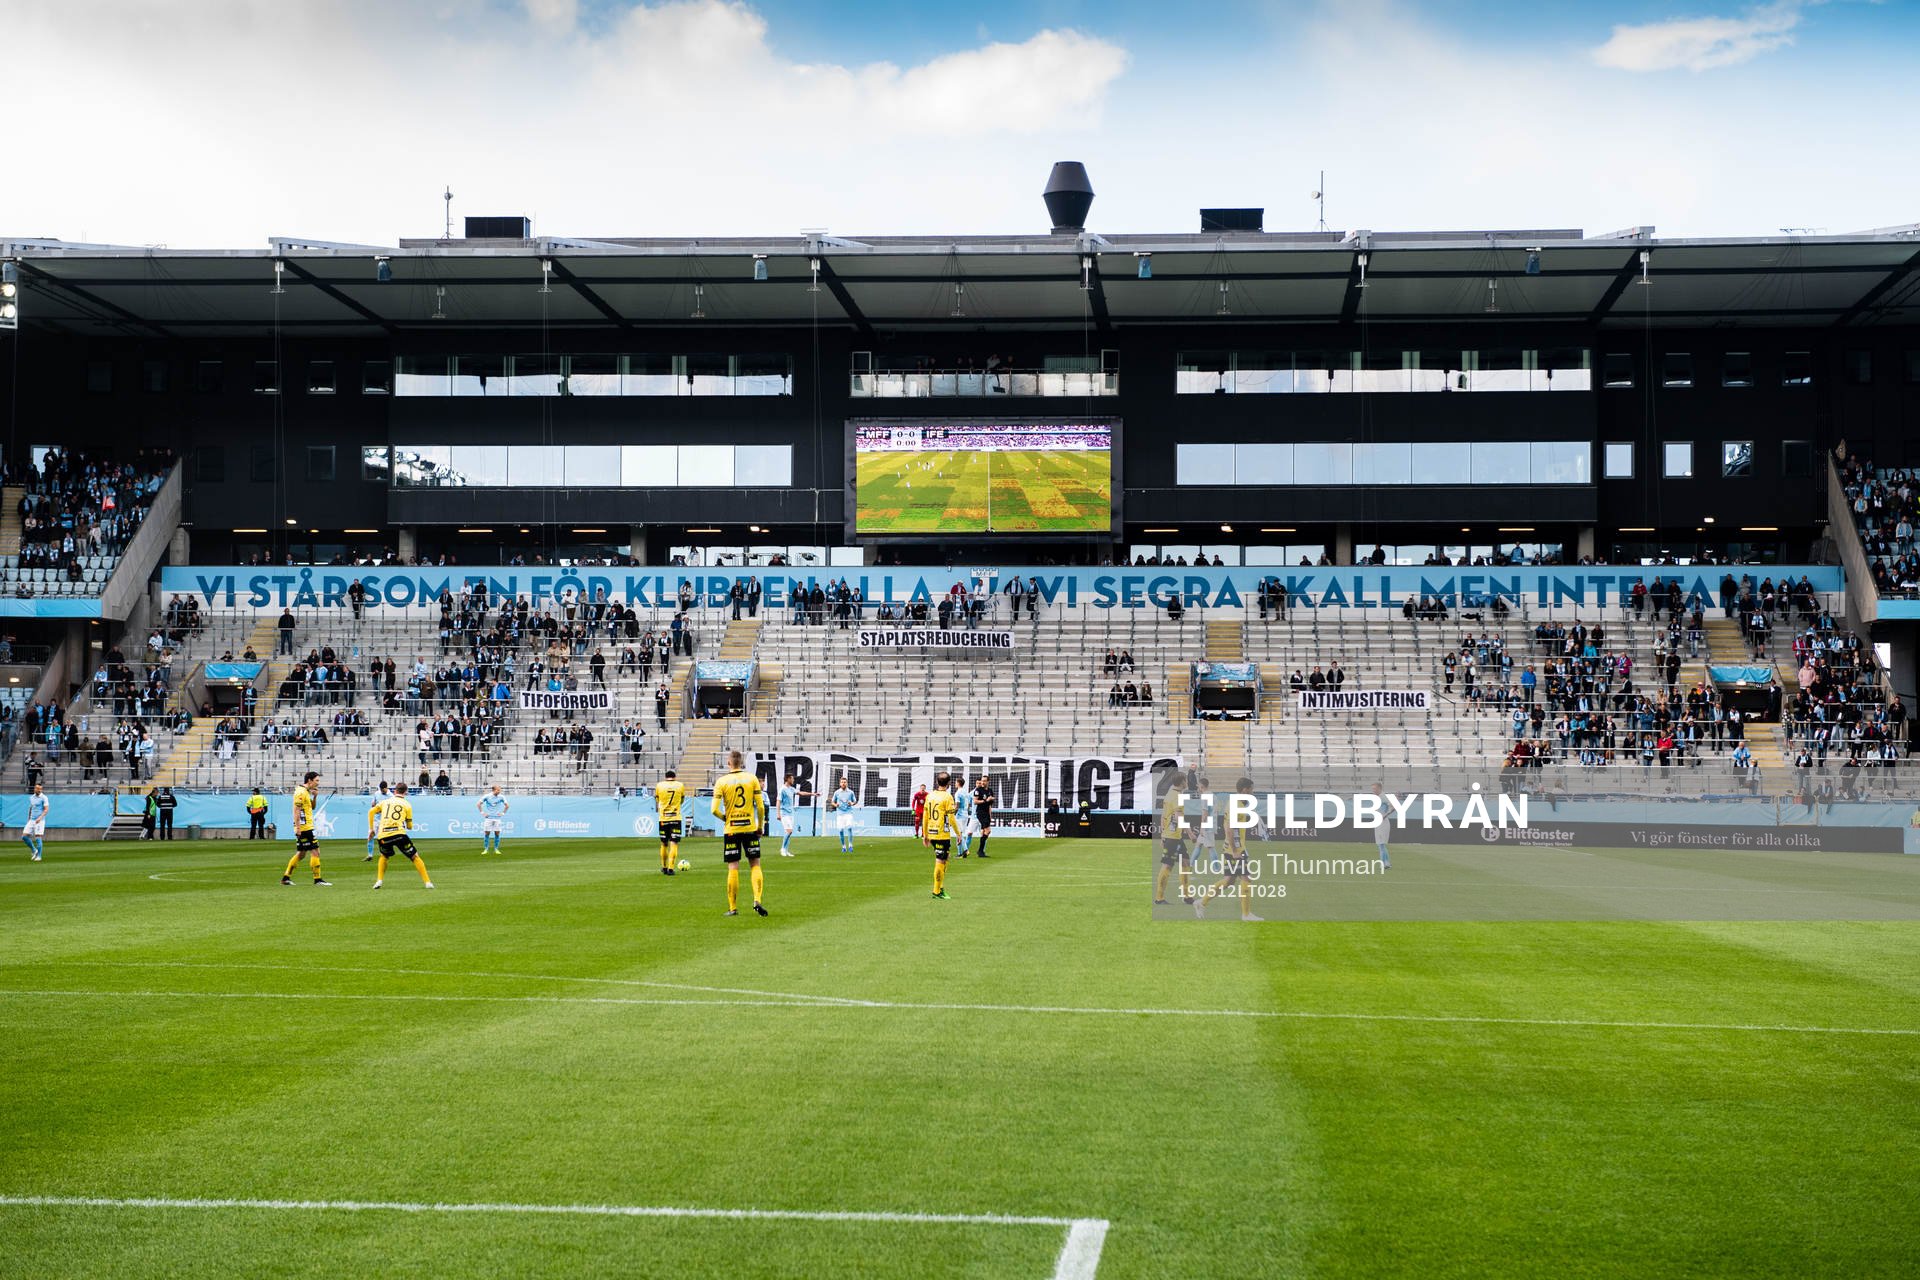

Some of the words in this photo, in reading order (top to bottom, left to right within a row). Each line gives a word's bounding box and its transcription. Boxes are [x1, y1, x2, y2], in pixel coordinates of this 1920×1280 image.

[866, 430, 889, 438] MFF
[926, 430, 944, 438] IFE
[196, 576, 235, 608] VI
[247, 567, 350, 608] STÅR
[366, 575, 450, 608] SOM
[531, 568, 613, 608] FÖR
[829, 576, 936, 608] LLA
[1034, 576, 1077, 608] VI
[1092, 575, 1244, 608] SEGRA
[1420, 576, 1520, 608] MEN
[1538, 576, 1644, 608] INTE
[522, 691, 608, 709] TIFOFÖRBUD
[1302, 691, 1425, 708] INTIMVISITERING
[755, 753, 813, 807] ÄR
[667, 790, 676, 806] 7
[734, 786, 746, 809] 3
[384, 803, 403, 820] 18
[928, 802, 940, 821] 16
[1119, 821, 1135, 833] Vi
[1504, 827, 1575, 841] Elitfönster
[1630, 831, 1646, 843] Vi
[1650, 832, 1674, 846] gör
[1678, 831, 1728, 845] fönster
[1732, 832, 1752, 846] för
[1756, 833, 1781, 846] alla
[1785, 833, 1821, 847] olika
